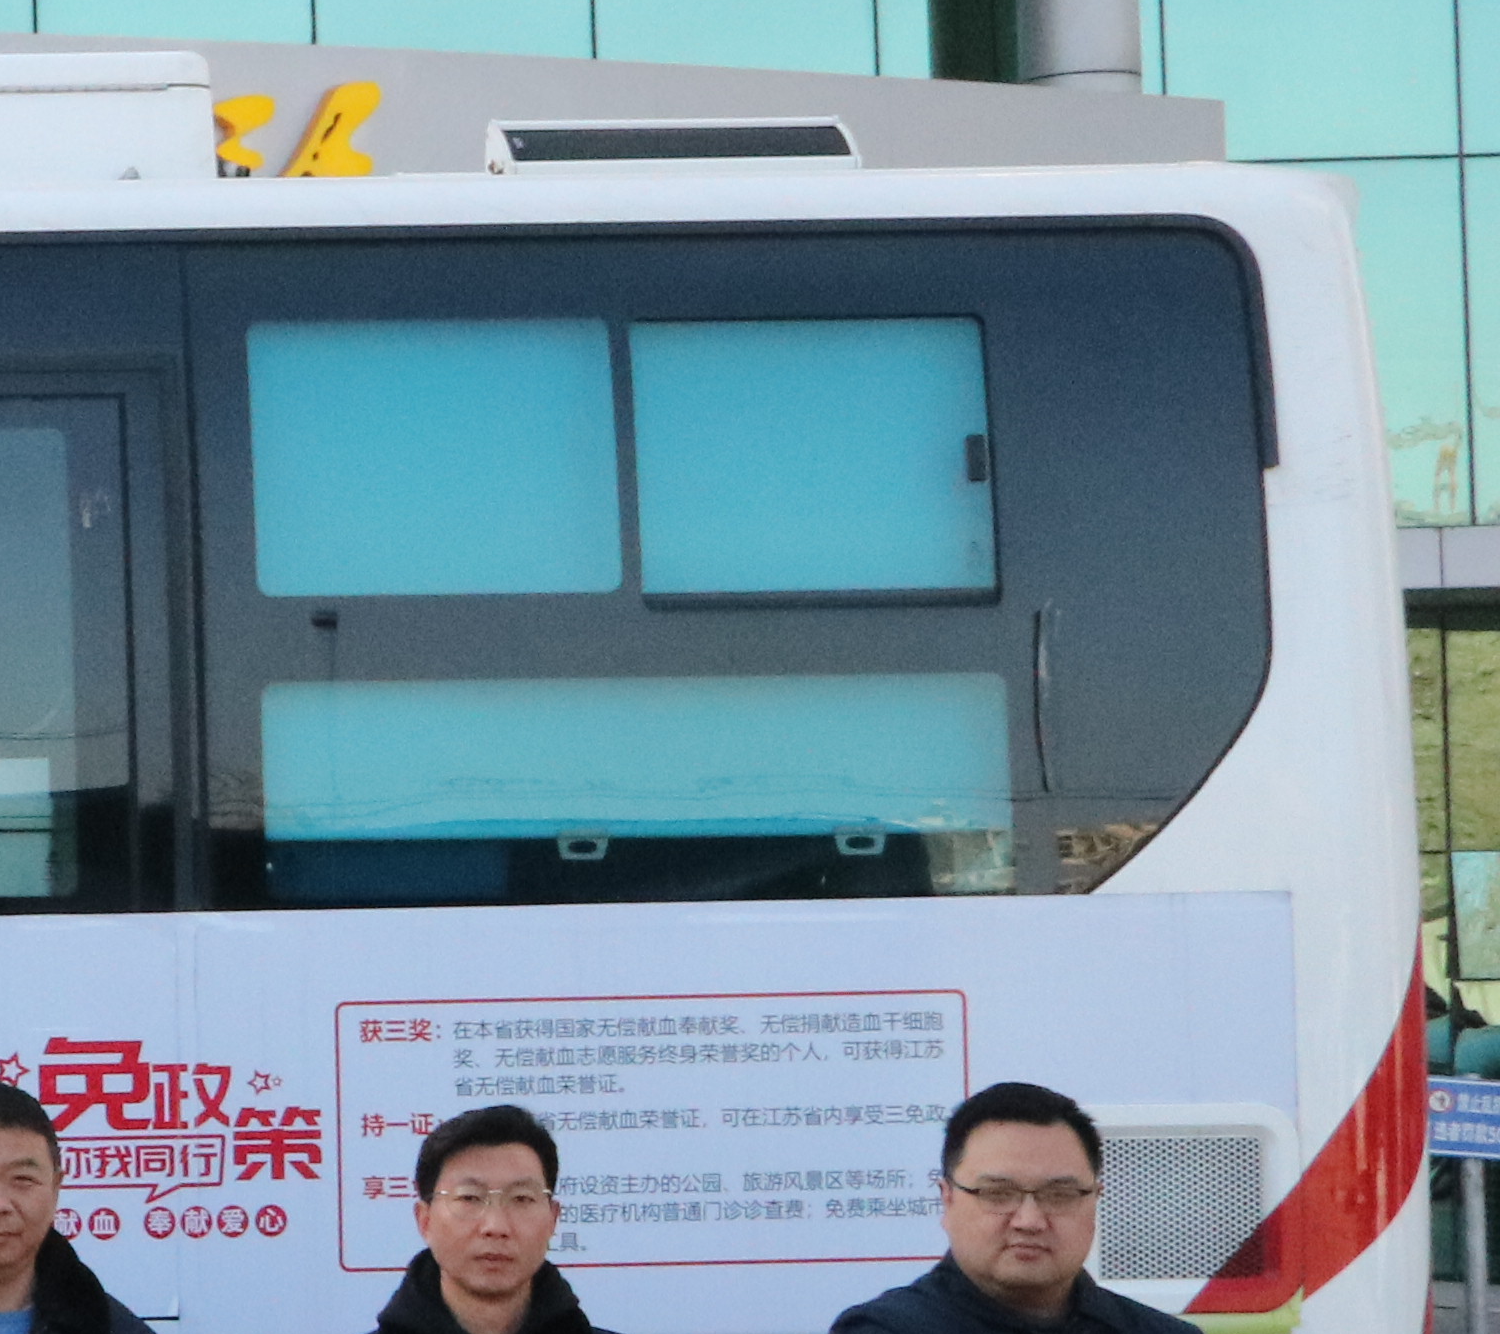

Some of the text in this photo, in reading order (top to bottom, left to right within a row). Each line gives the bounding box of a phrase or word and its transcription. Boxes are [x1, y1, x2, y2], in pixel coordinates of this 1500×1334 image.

[363, 1175, 421, 1200] 享三
[146, 1207, 287, 1237] 奉献爱心
